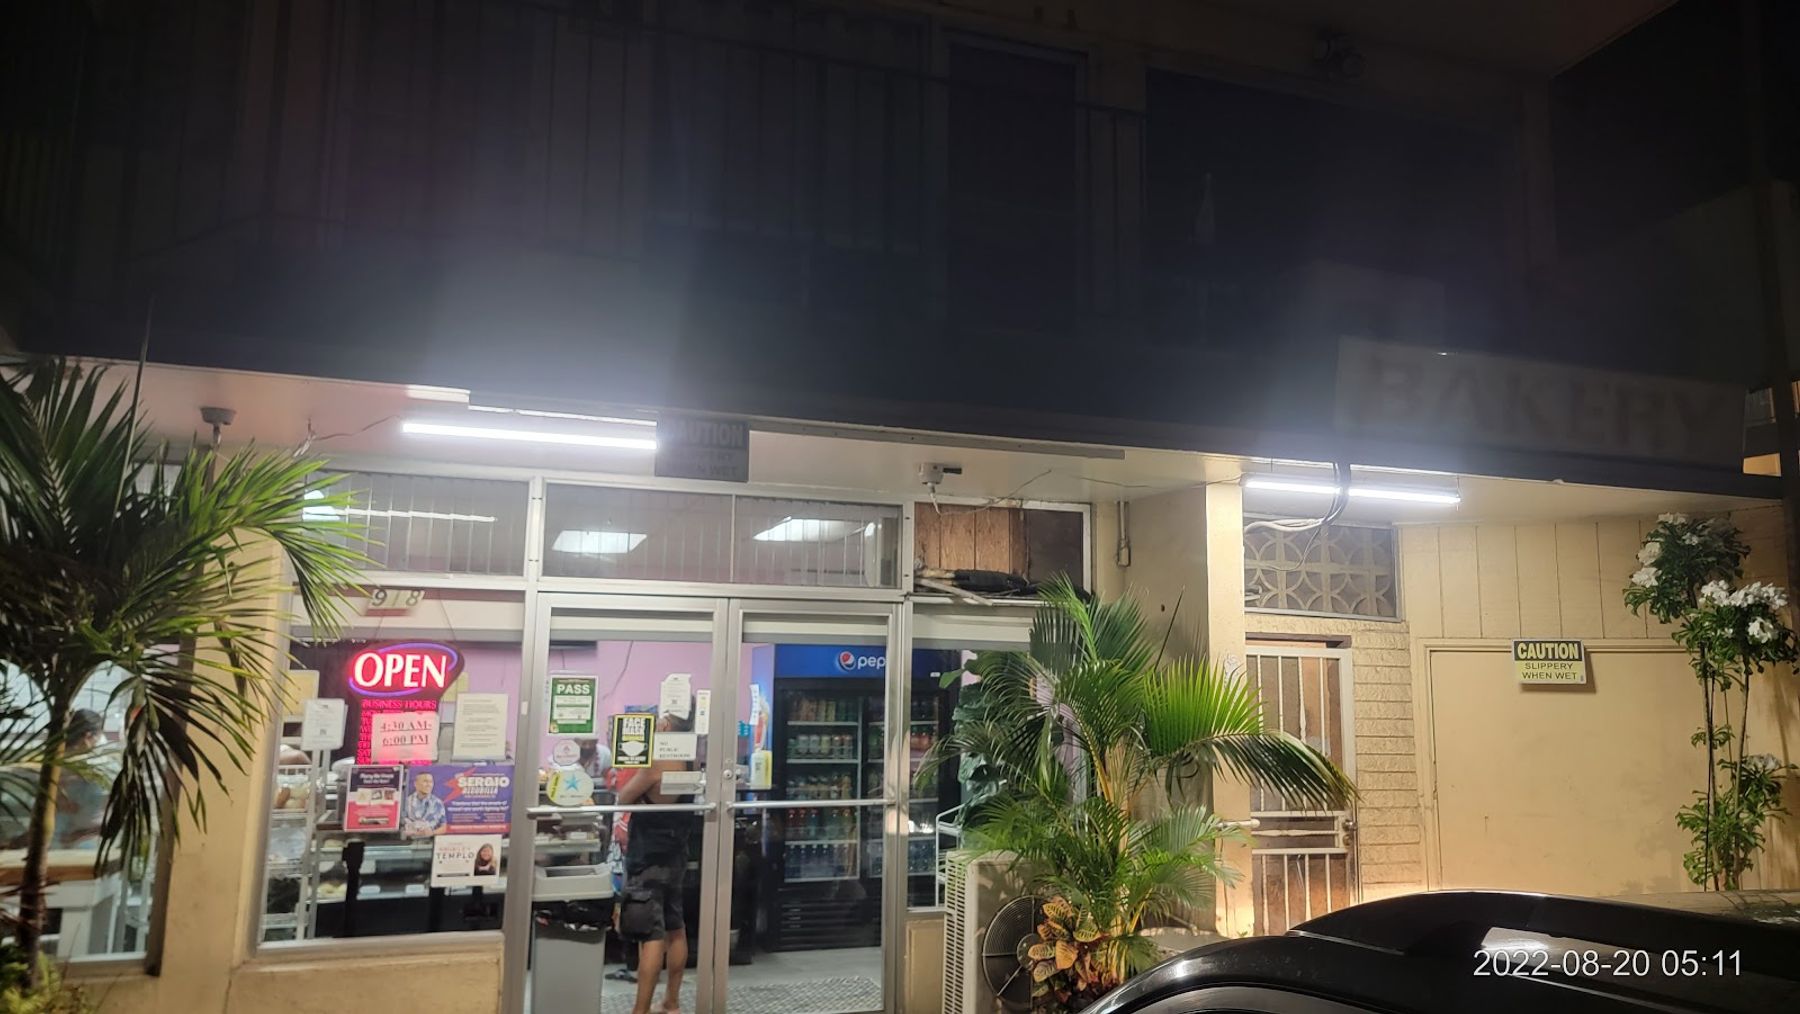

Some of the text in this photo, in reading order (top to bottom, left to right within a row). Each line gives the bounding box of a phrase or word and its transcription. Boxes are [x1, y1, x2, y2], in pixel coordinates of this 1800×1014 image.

[1356, 355, 1726, 455] BAKERY
[1517, 642, 1579, 660] CAUTION
[857, 656, 886, 669] pep
[1525, 662, 1573, 670] SLIPPERY
[354, 652, 447, 688] OPEN
[556, 684, 590, 694] PASS
[362, 699, 437, 709] BUSINESS HOURS
[381, 722, 405, 731] 4:30
[383, 735, 429, 745] 6:00 PM
[458, 776, 510, 788] SERGIO
